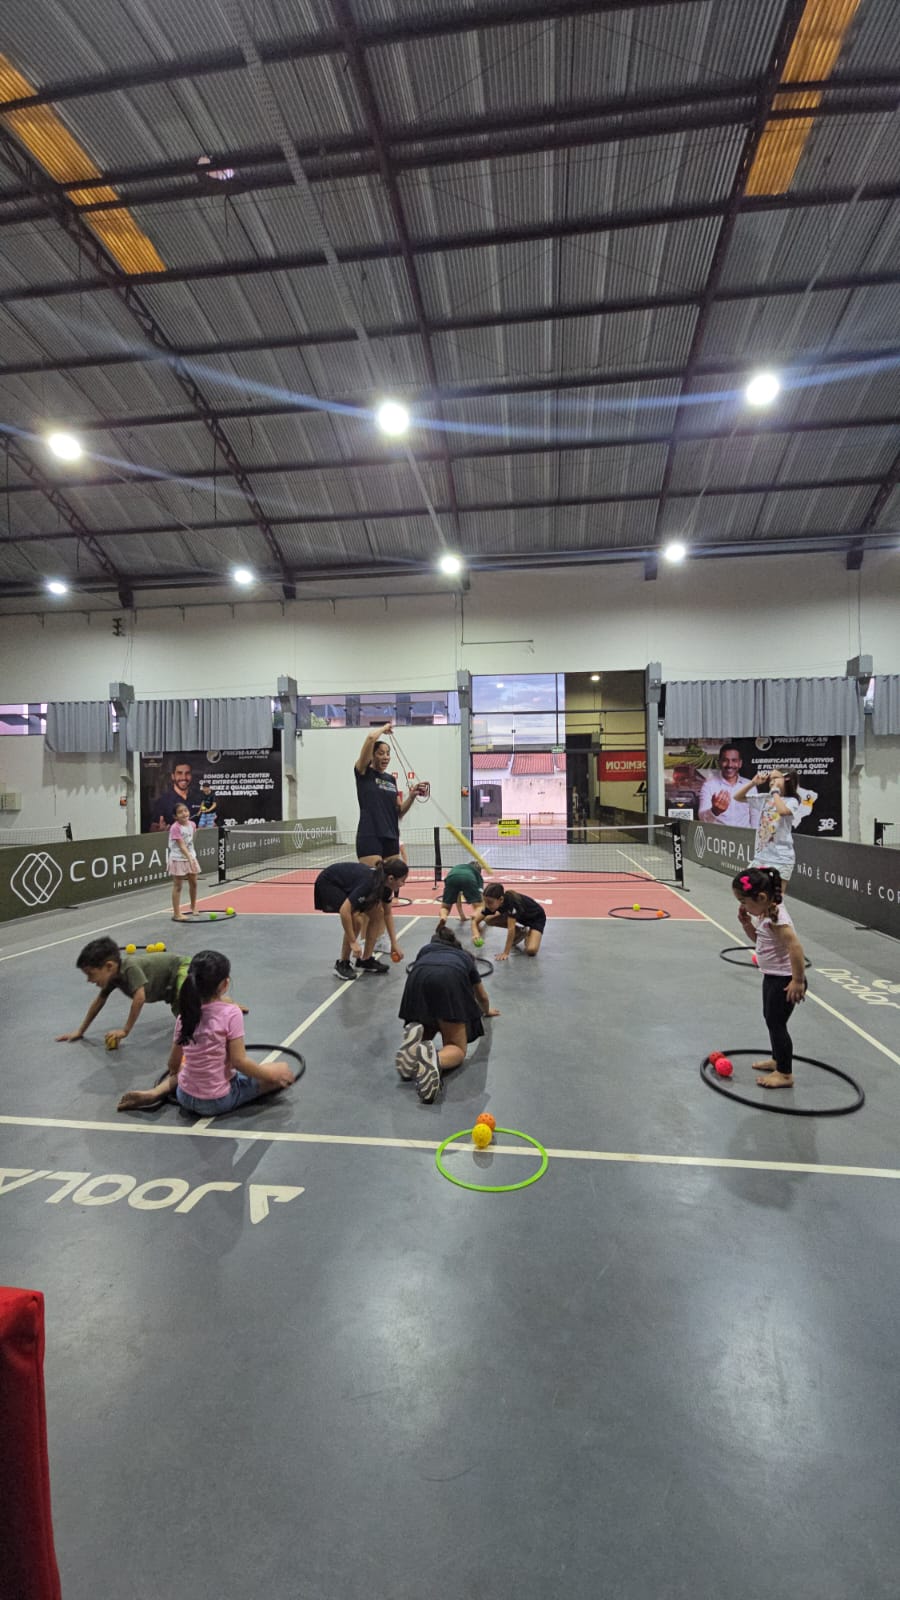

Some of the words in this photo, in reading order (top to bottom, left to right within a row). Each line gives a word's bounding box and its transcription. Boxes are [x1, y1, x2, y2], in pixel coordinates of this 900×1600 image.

[674, 842, 682, 870] JOOLA
[705, 836, 754, 863] CORPAL
[797, 863, 813, 877] NÃO
[867, 880, 872, 896] É
